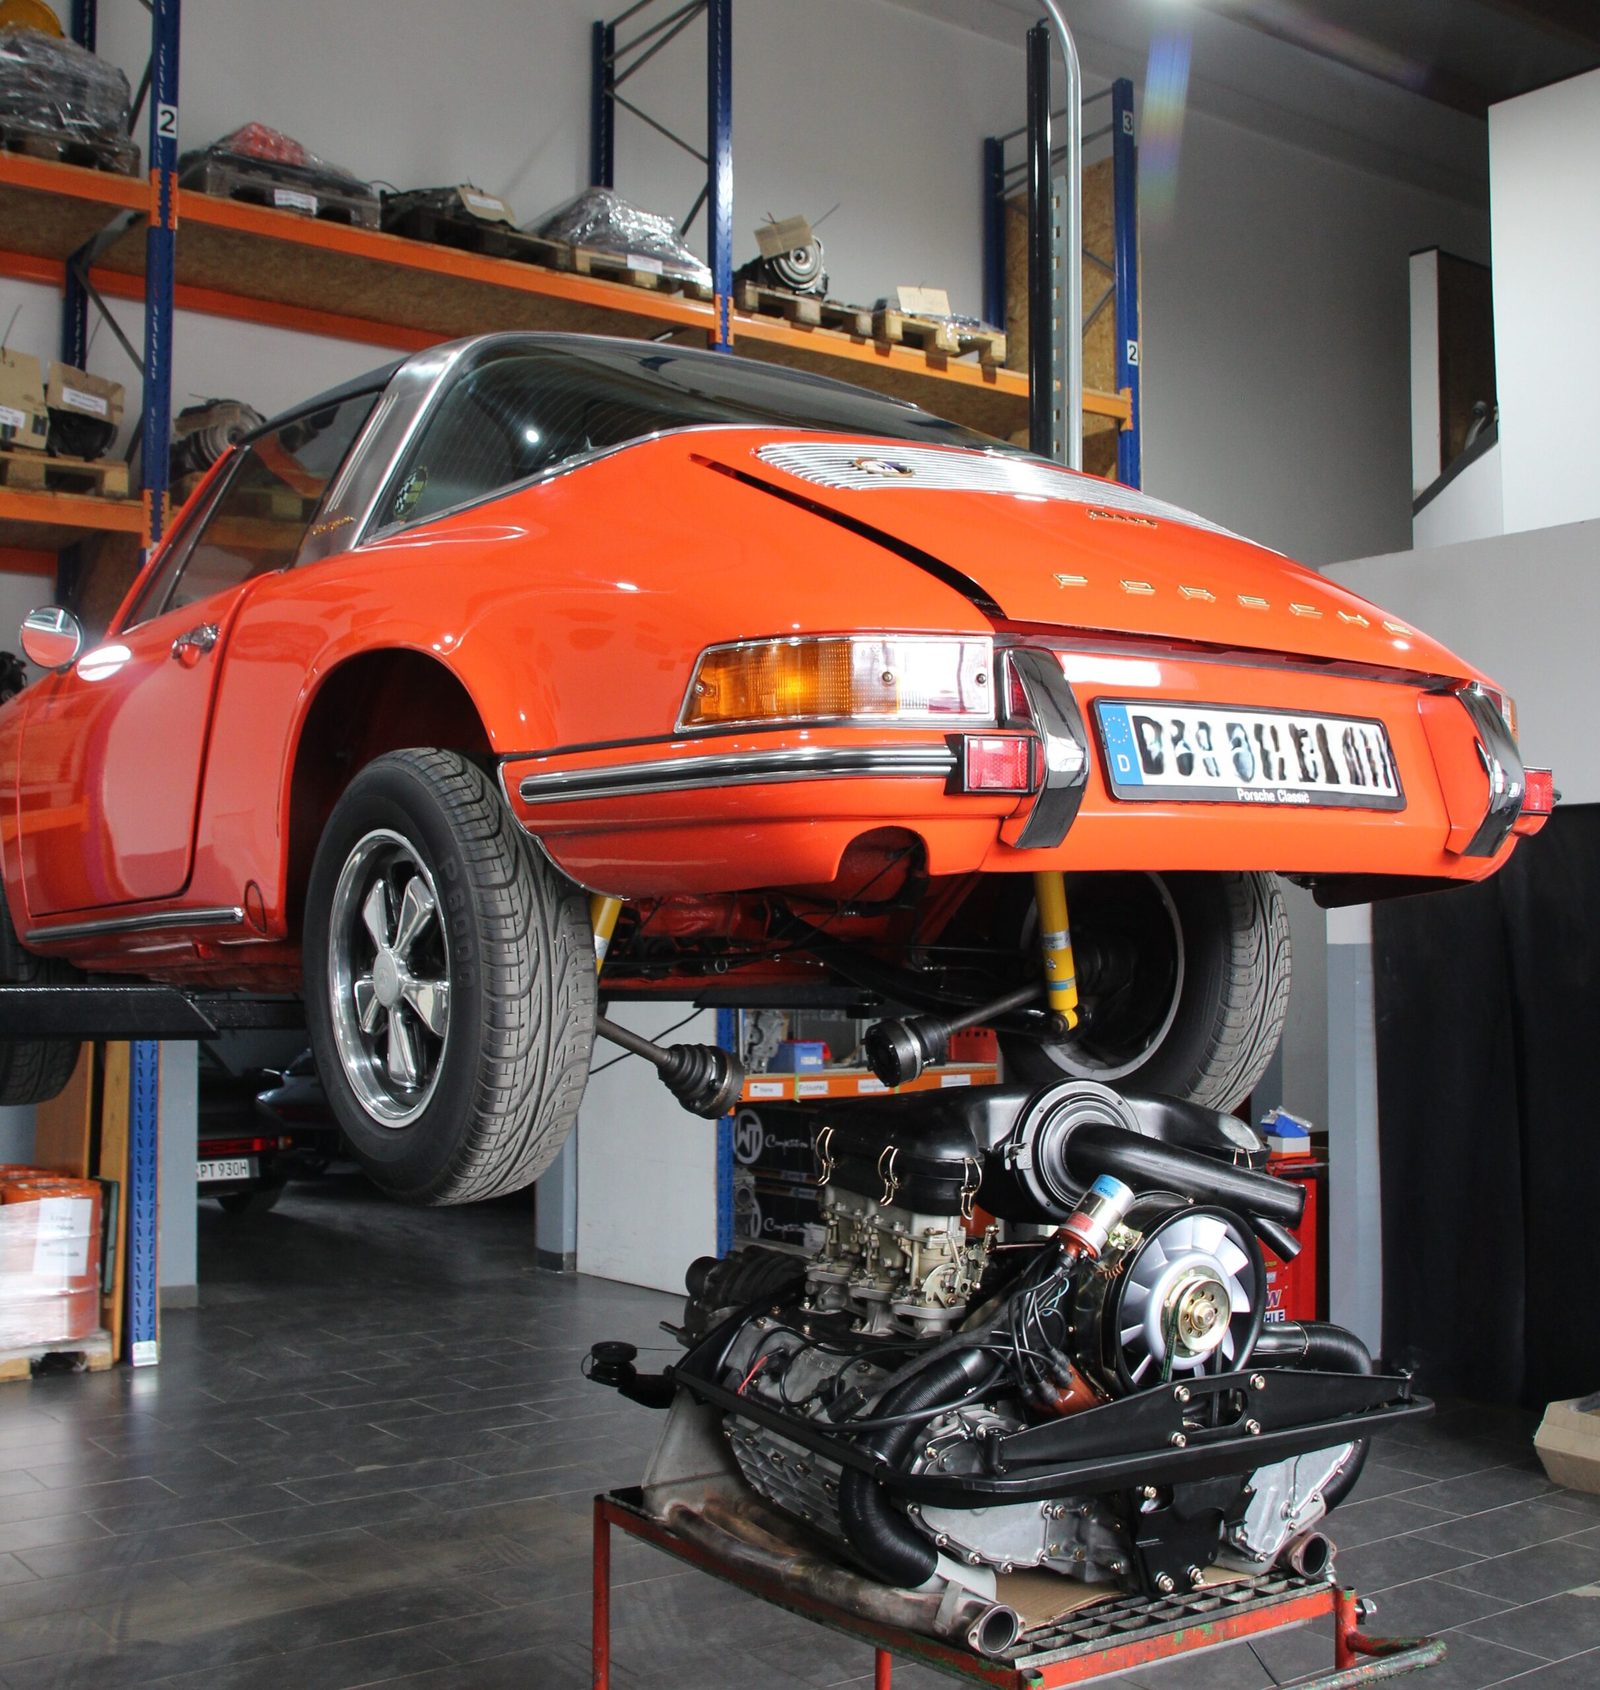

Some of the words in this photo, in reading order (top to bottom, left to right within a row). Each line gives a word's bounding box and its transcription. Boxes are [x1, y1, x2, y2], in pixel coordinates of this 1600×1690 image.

[160, 110, 176, 134] 2
[1124, 114, 1132, 132] 3
[1128, 344, 1137, 362] 2
[1053, 572, 1413, 636] PORSCHE
[1116, 753, 1131, 772] D
[1236, 787, 1276, 802] Porsche
[1277, 788, 1311, 804] Classic
